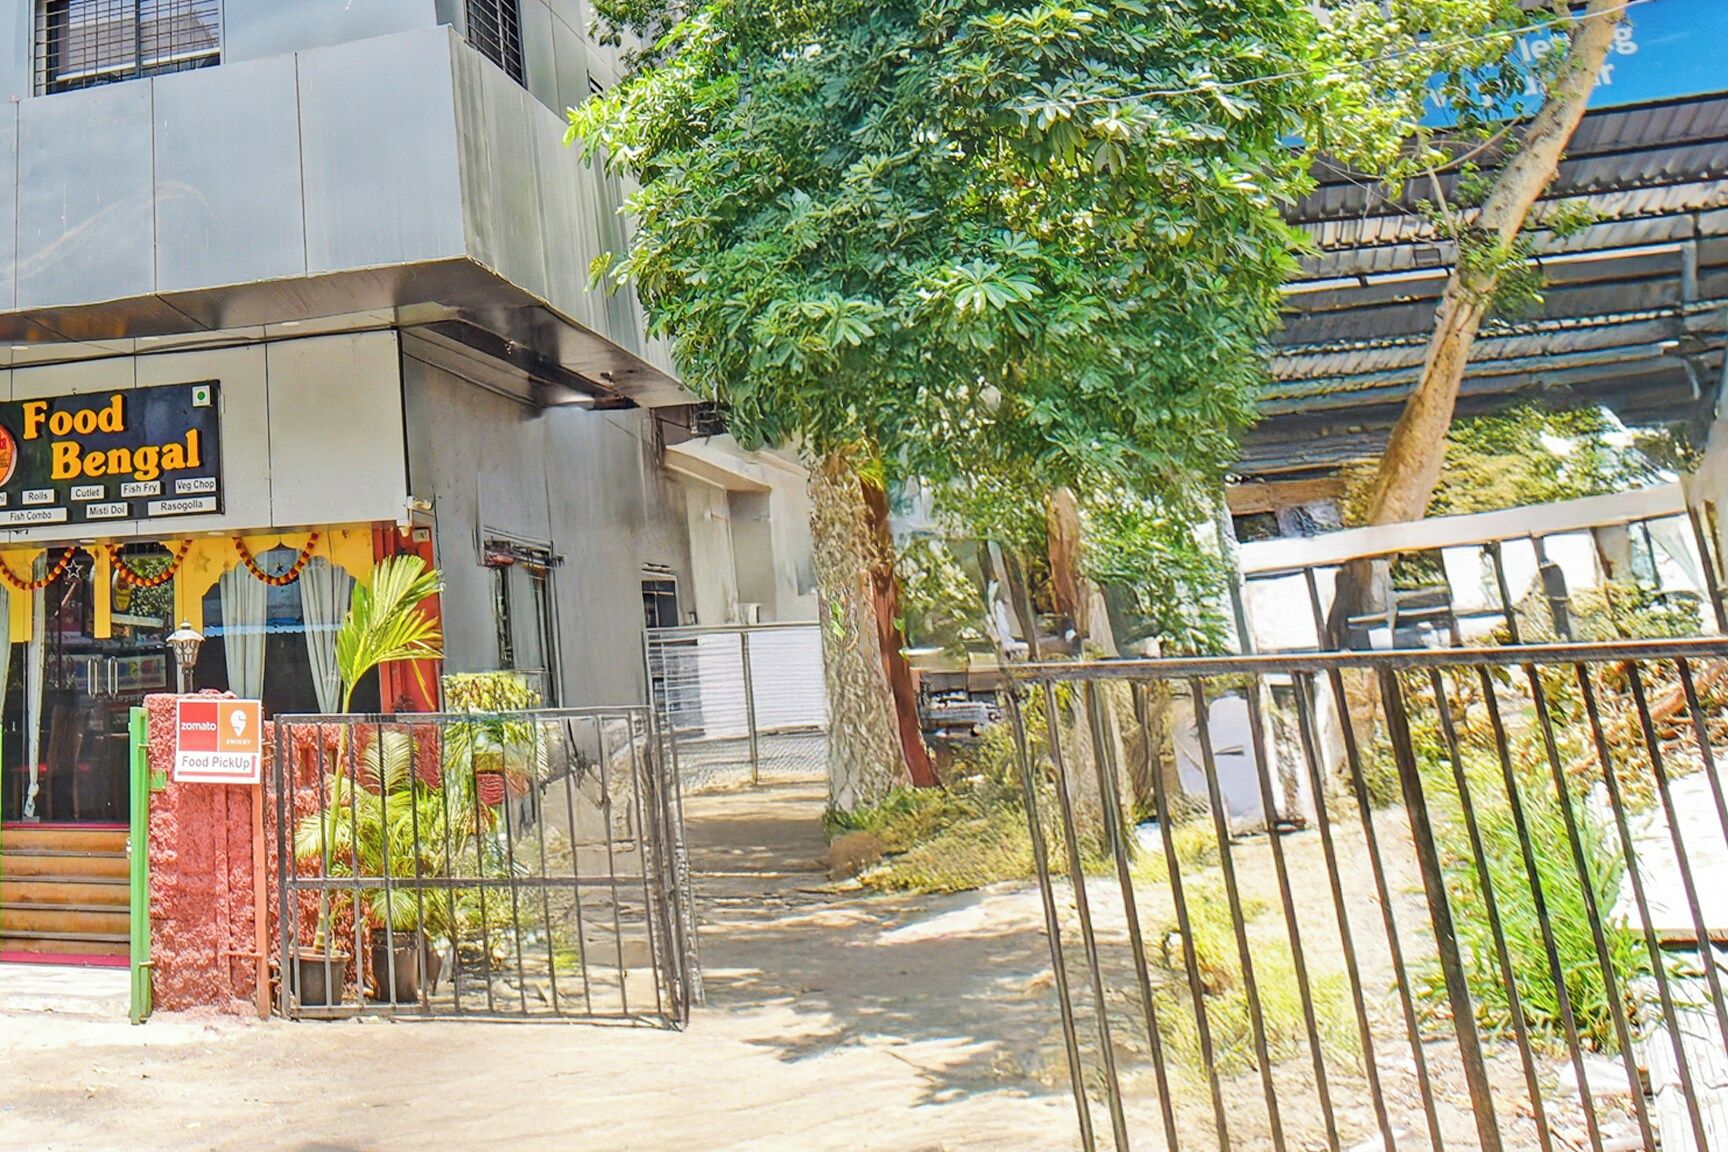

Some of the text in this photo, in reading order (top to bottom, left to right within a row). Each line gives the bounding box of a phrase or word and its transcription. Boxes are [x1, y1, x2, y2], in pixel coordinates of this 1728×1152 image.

[22, 394, 125, 440] Food
[50, 428, 201, 481] Bengal
[123, 483, 158, 494] Fish Fry
[177, 479, 214, 490] Veg Chop
[28, 492, 48, 501] Rolls
[75, 487, 100, 497] Cutlet
[89, 505, 109, 515] Misti
[160, 499, 203, 512] Rasogolla
[10, 511, 52, 521] Fish Combo
[181, 721, 217, 731] zomato
[181, 755, 250, 771] Food PickUp
